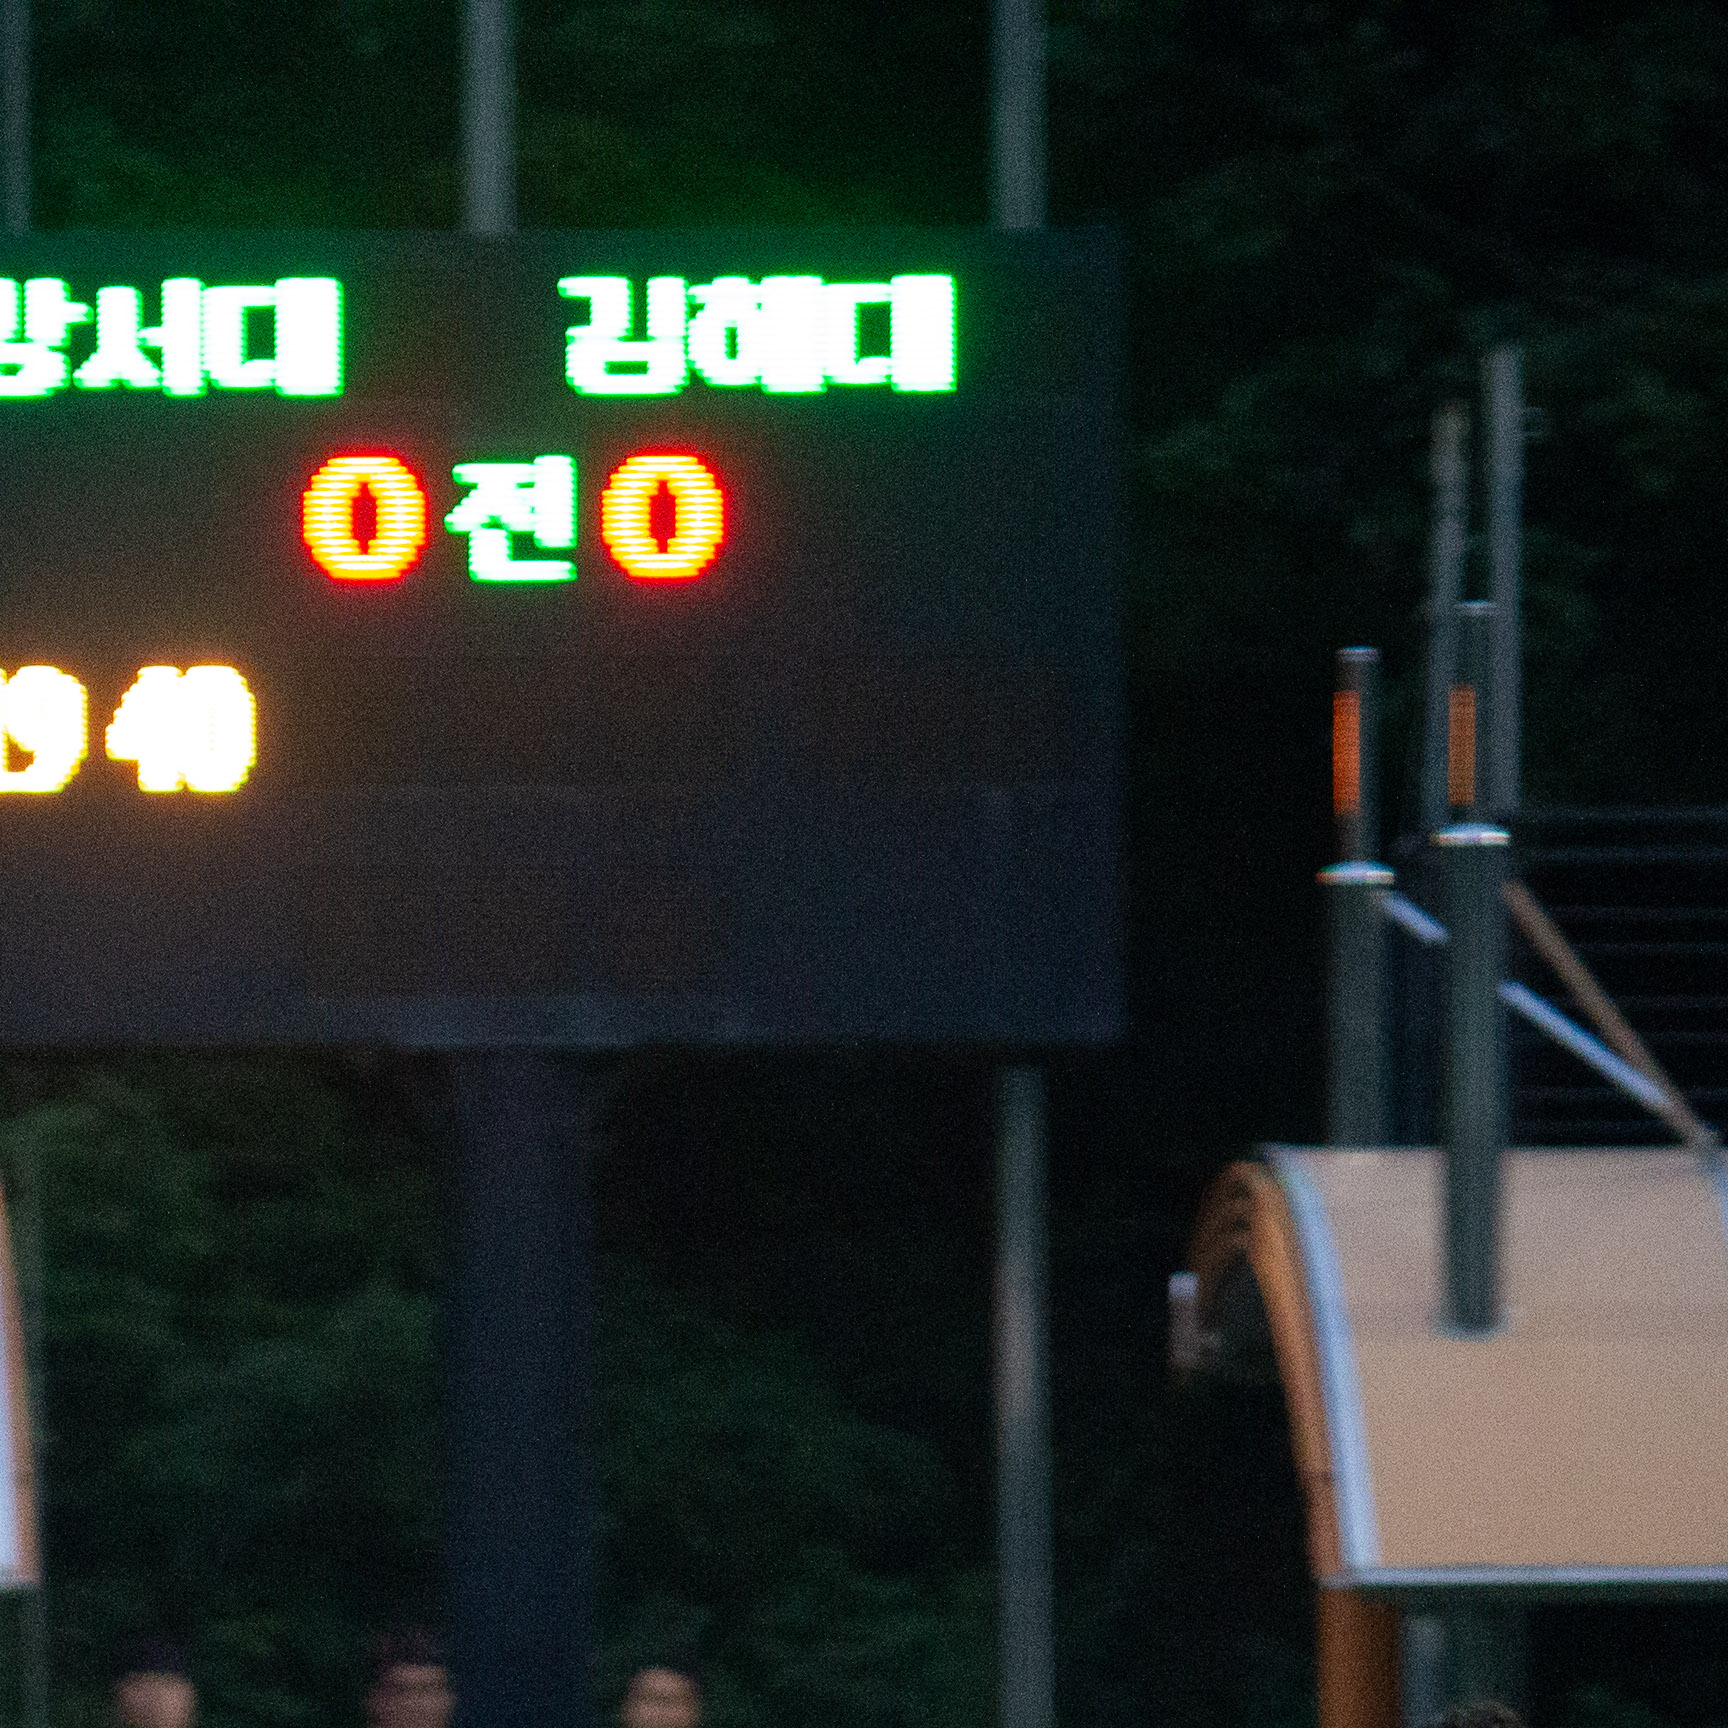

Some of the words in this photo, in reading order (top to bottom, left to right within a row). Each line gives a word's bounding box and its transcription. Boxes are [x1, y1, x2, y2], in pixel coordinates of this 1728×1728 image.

[557, 274, 957, 395] 김해대
[301, 455, 426, 580] 0
[446, 454, 575, 582] 전
[601, 454, 725, 579] 0
[104, 664, 257, 793] 40
